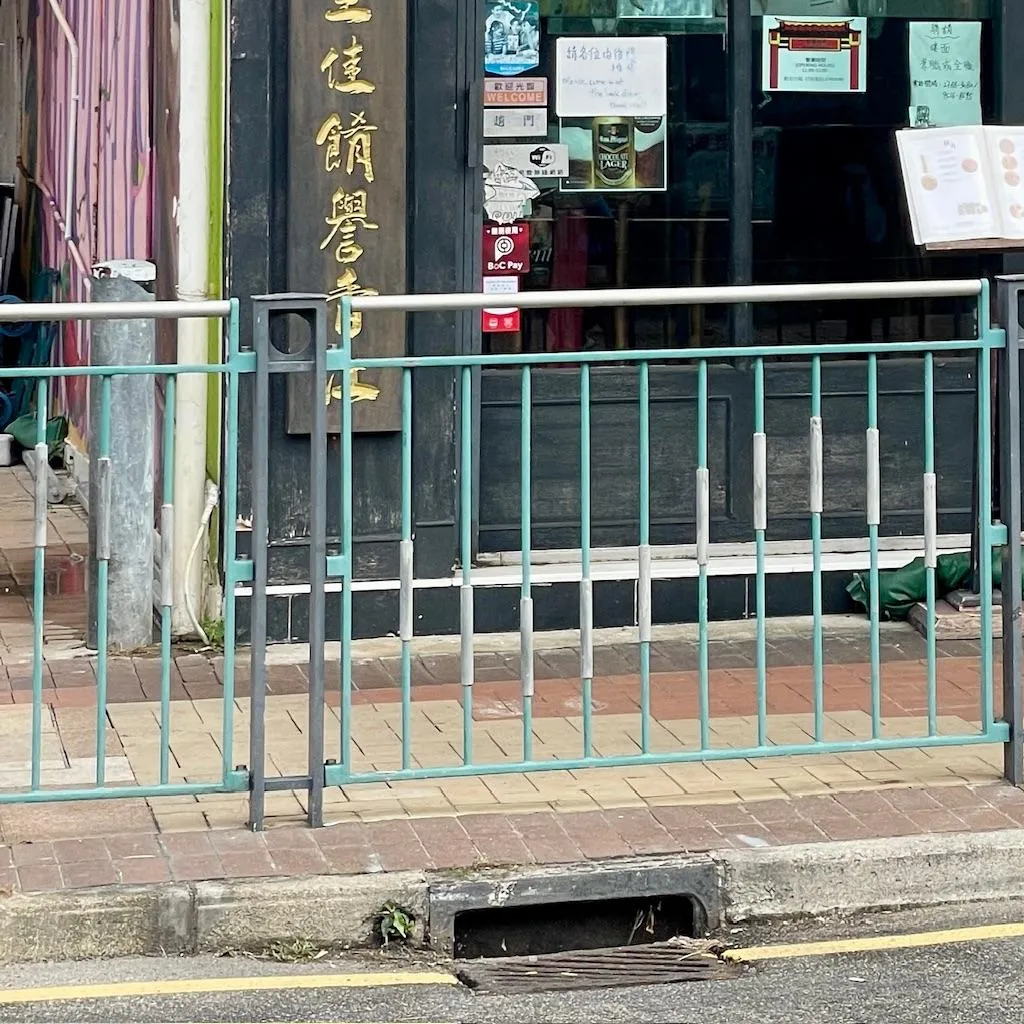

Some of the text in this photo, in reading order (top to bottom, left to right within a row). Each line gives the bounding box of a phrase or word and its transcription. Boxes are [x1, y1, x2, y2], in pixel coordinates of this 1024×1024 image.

[487, 91, 542, 102] WELCOME
[600, 160, 628, 171] LAGER
[507, 260, 524, 271] Pay
